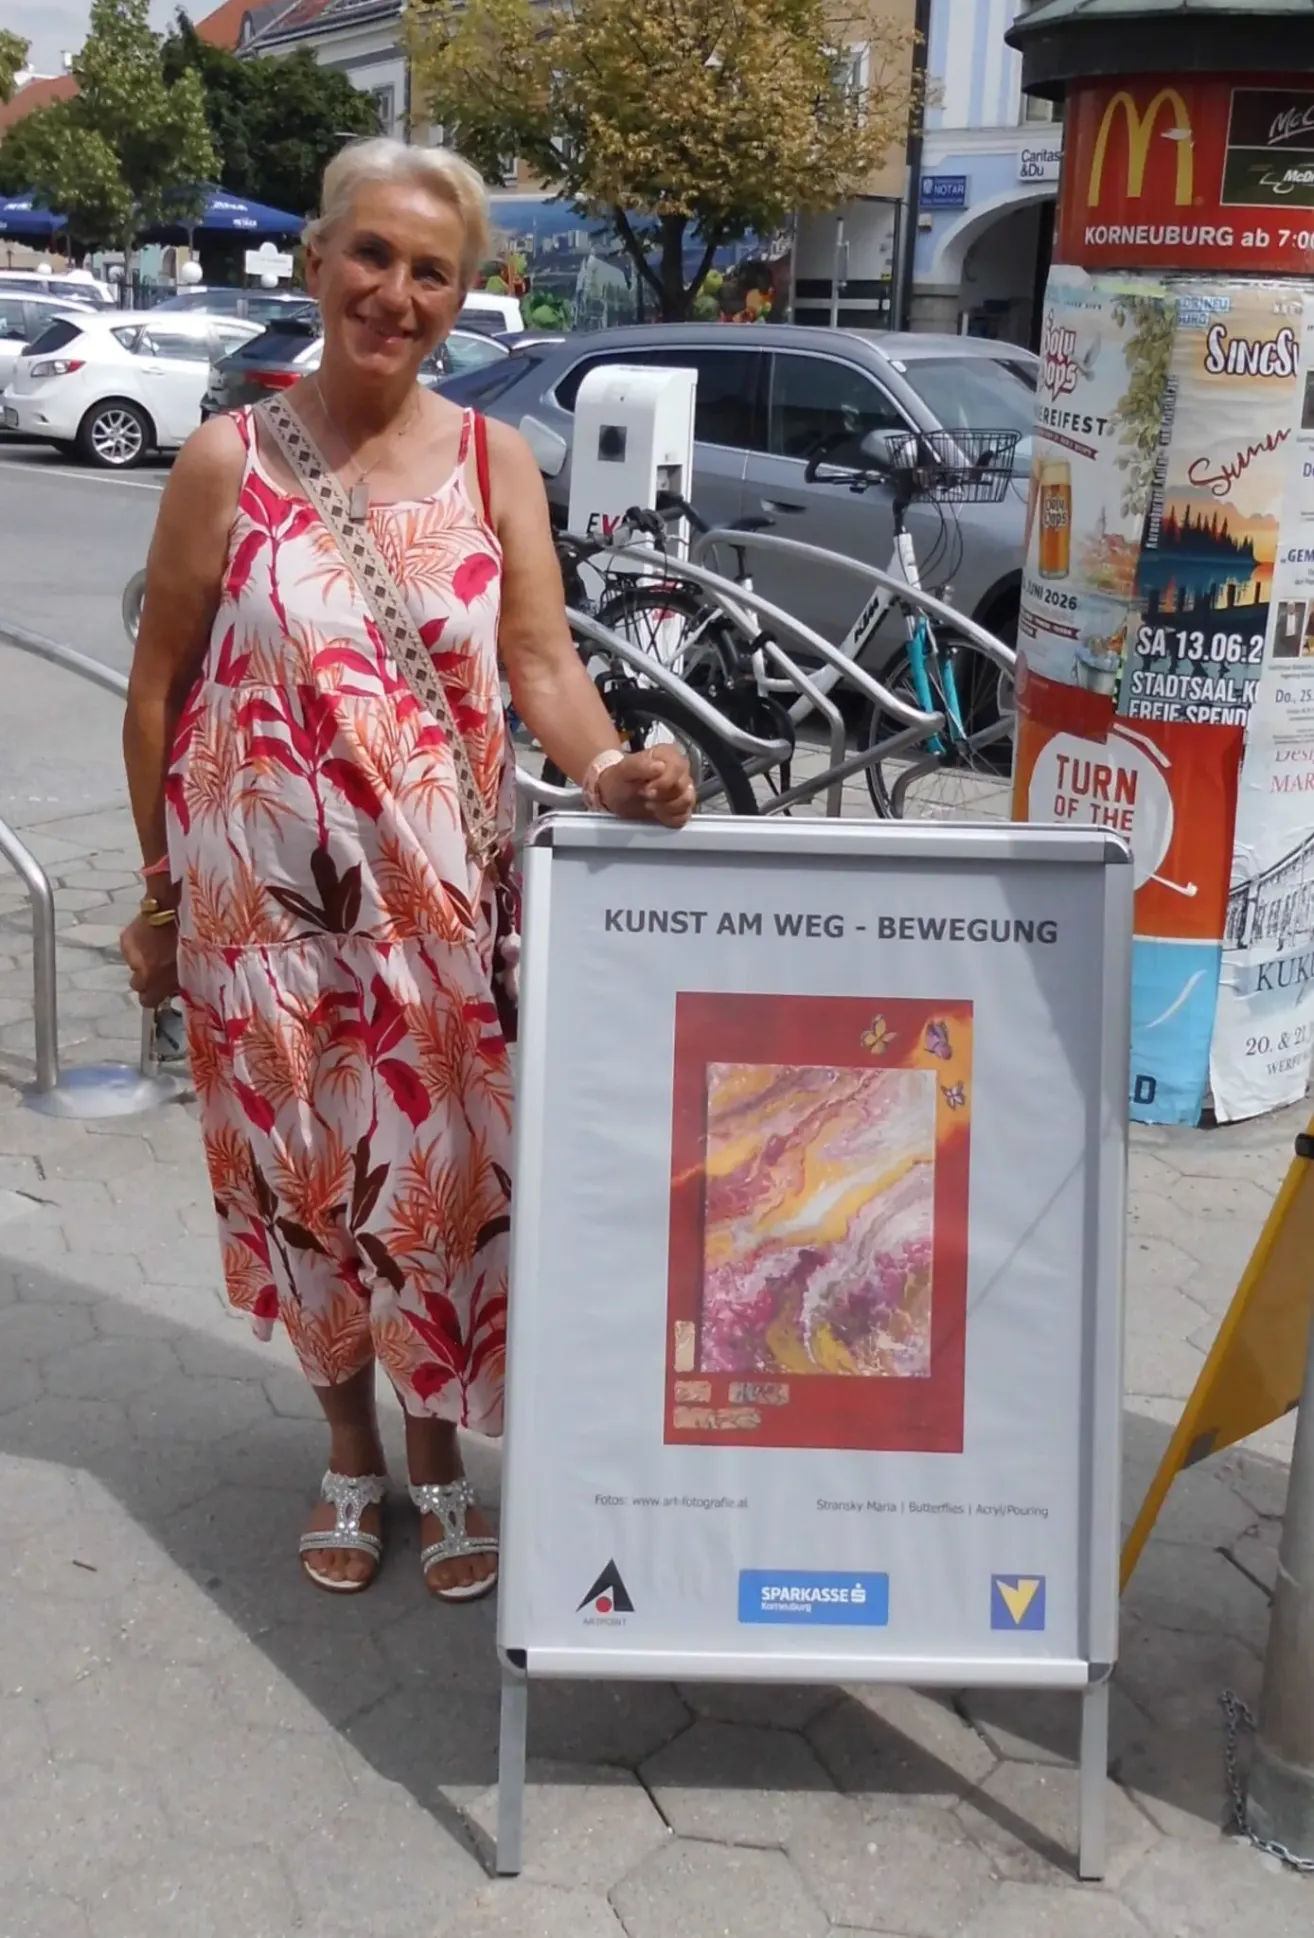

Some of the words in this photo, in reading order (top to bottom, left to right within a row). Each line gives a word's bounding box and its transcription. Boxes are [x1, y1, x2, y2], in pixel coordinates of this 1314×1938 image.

[1021, 149, 1061, 163] Caritas
[934, 184, 965, 196] NOTAR
[1084, 226, 1234, 247] KORNEUBURG
[1241, 231, 1270, 248] ab
[1044, 588, 1078, 611] 2026
[1131, 670, 1237, 702] STADTSAAL
[1129, 699, 1181, 722] FREIE
[1056, 753, 1138, 805] TURN
[1054, 794, 1079, 818] OF
[1090, 802, 1134, 831] THE
[605, 909, 707, 934] KUNST
[716, 913, 762, 936] AM
[773, 914, 844, 938] WEG
[878, 916, 1058, 943] BEWEGUNG
[1277, 1031, 1289, 1050] &
[595, 1494, 627, 1506] Fotos:
[816, 1499, 863, 1513] Stransky
[866, 1501, 897, 1513] Maria
[909, 1502, 965, 1515] Butterflies
[976, 1504, 1049, 1519] Acryl/Pouring
[761, 1586, 849, 1602] SPARKASSE
